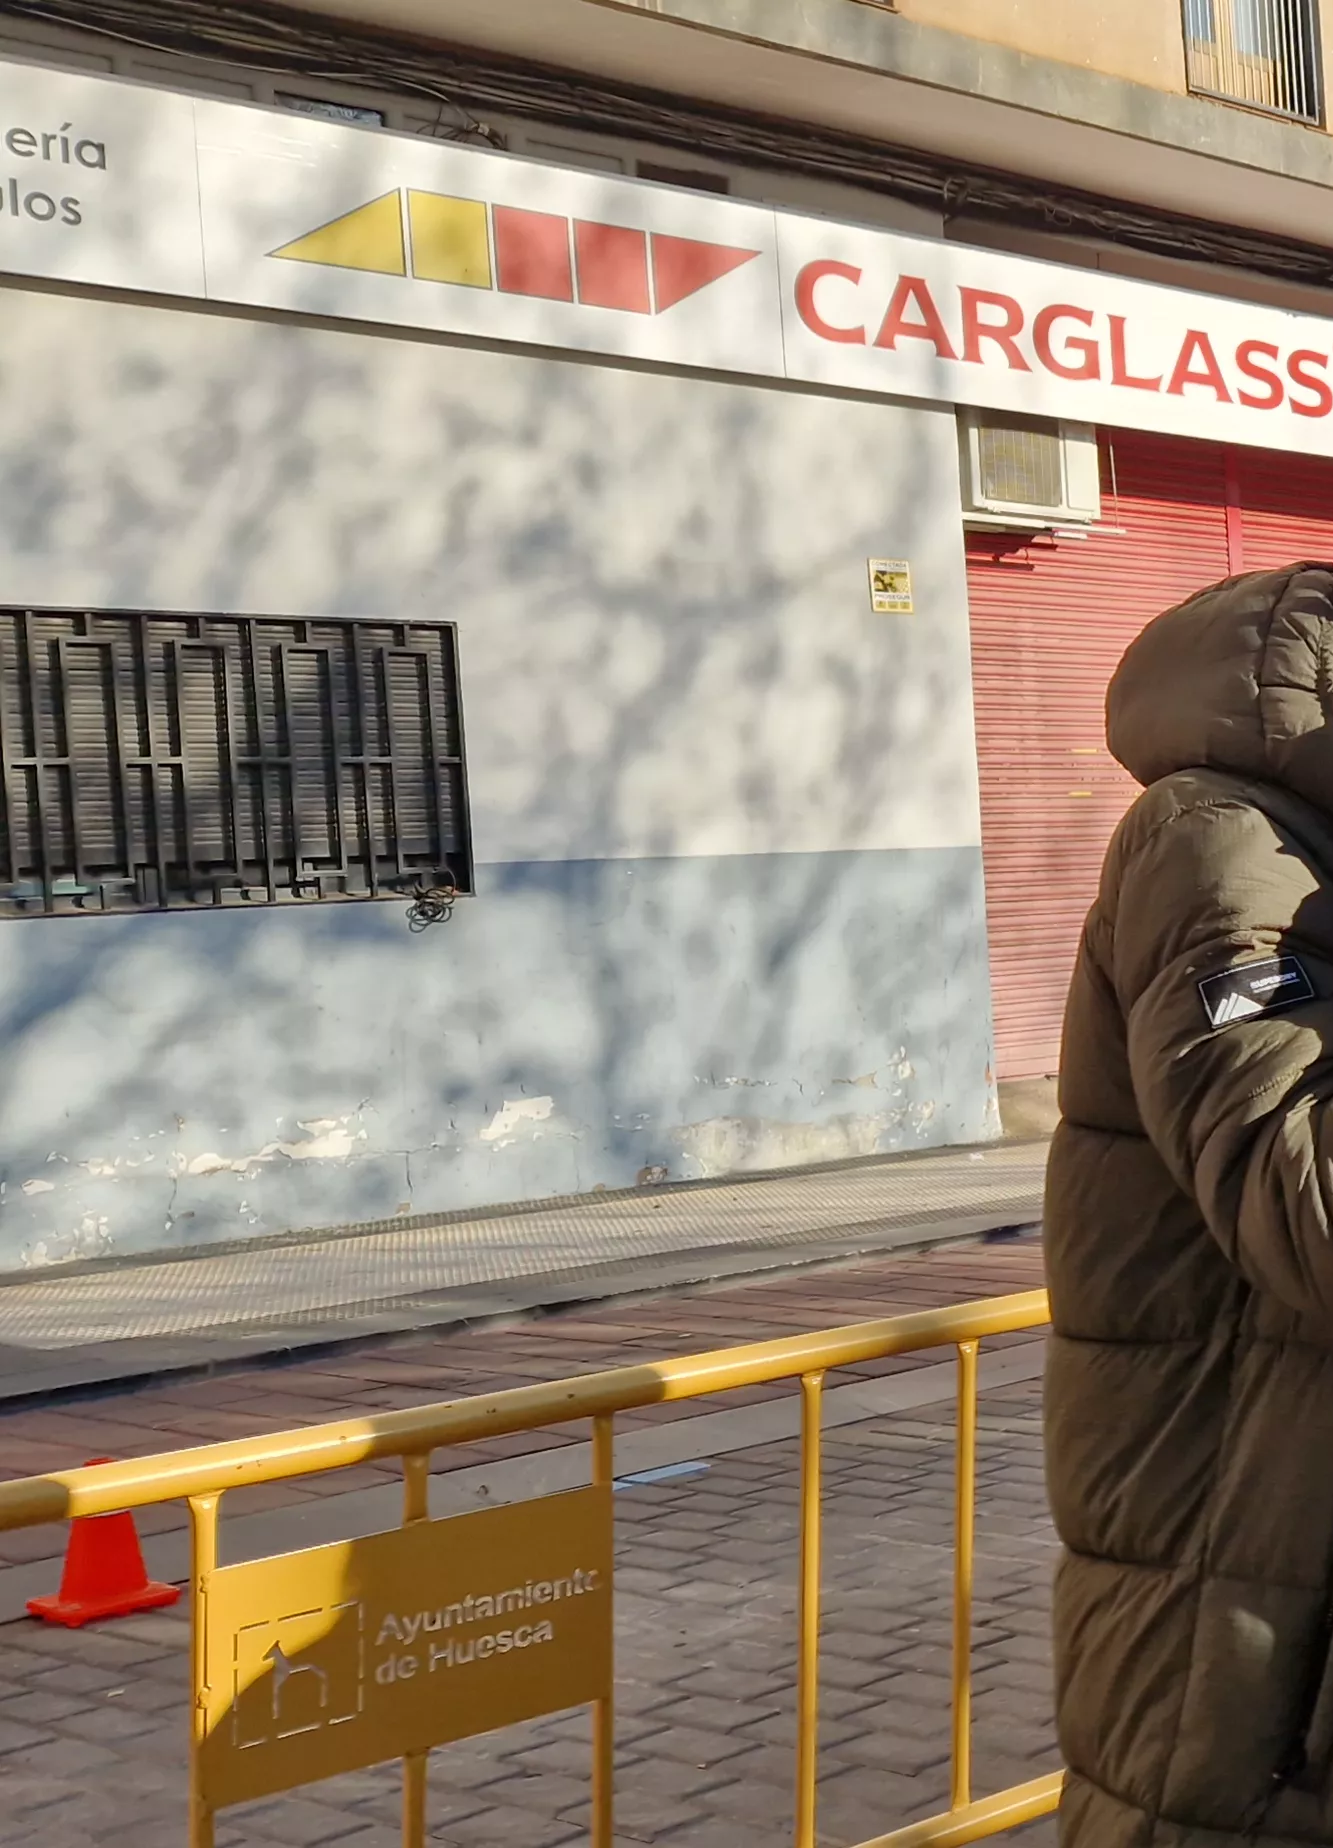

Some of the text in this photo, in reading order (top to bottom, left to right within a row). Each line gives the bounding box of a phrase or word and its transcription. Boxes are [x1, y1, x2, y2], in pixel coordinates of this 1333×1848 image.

[5, 122, 107, 171] ería
[0, 177, 82, 226] los
[375, 1567, 601, 1646] Ayuntamiento
[375, 1619, 554, 1684] de Huesca
